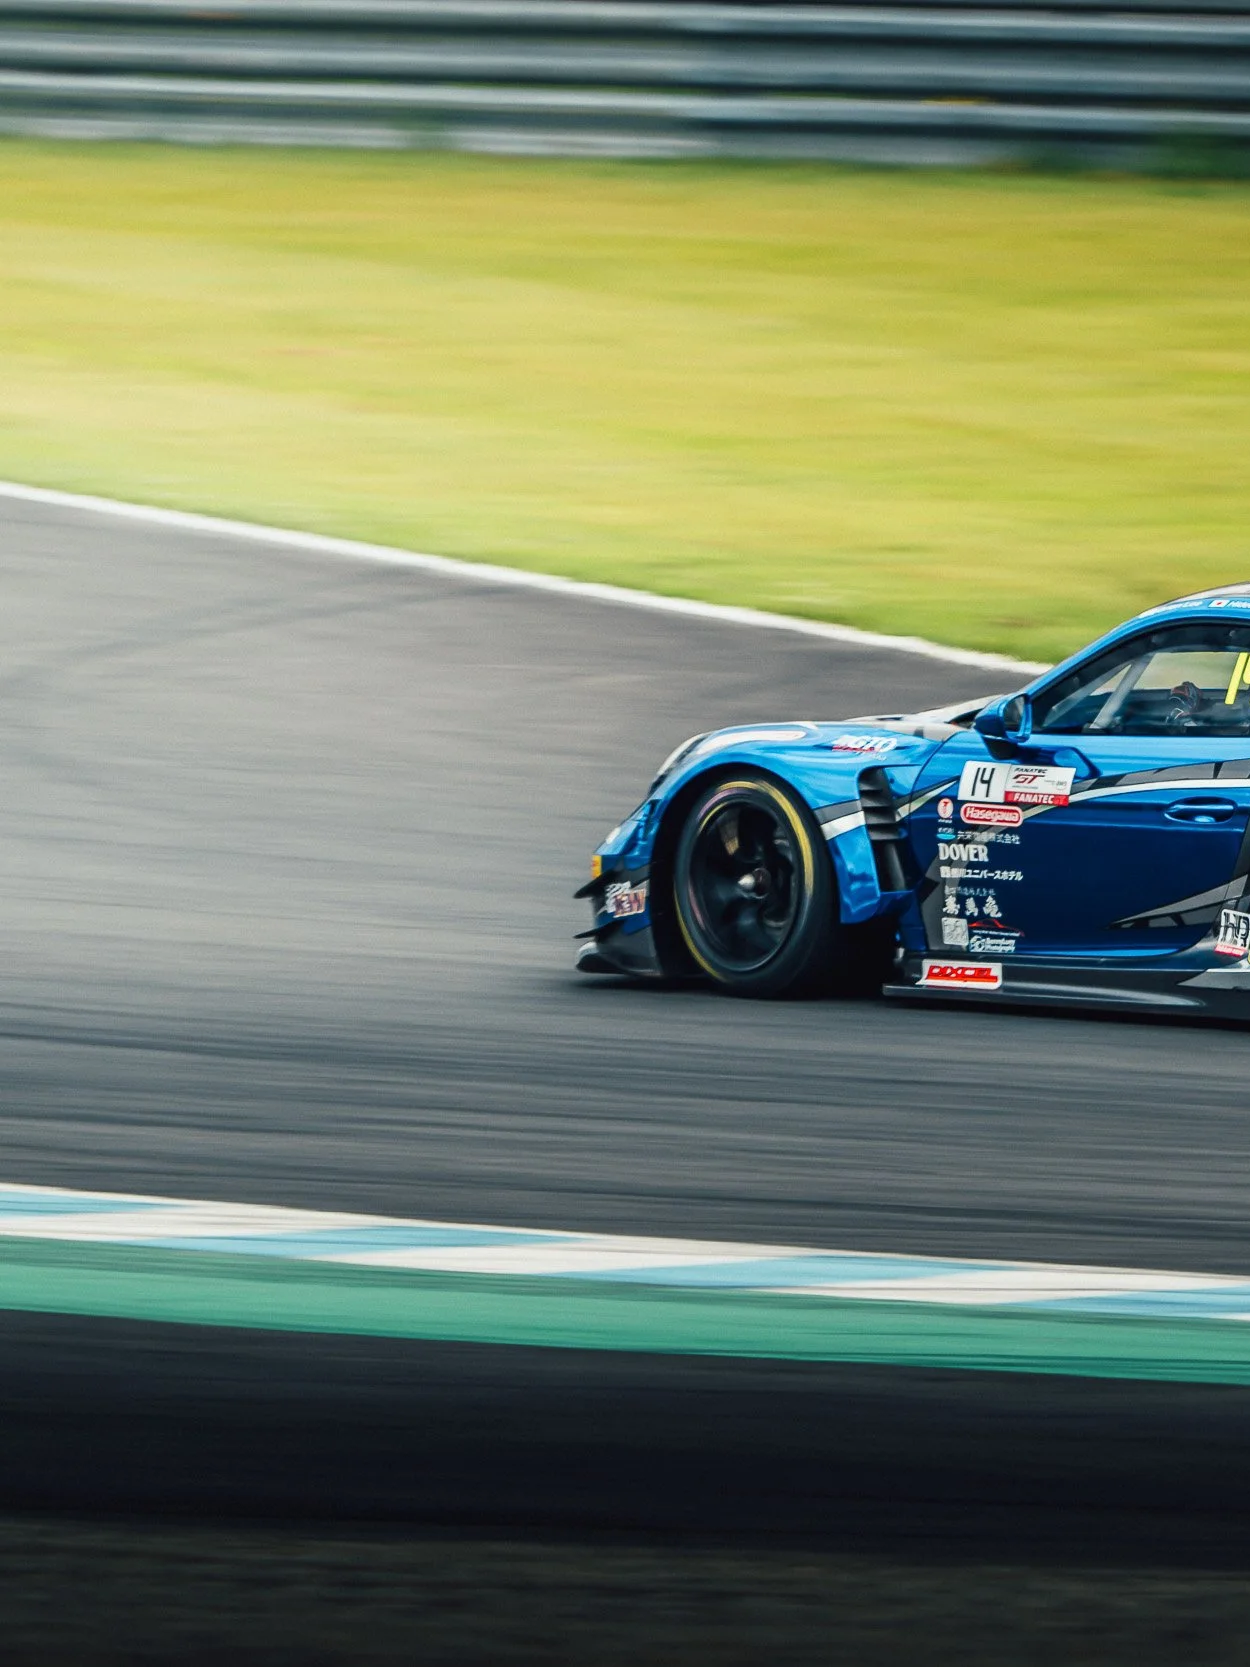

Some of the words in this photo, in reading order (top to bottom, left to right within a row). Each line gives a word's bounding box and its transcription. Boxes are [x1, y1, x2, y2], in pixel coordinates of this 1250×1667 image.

[970, 766, 996, 798] 14
[1012, 793, 1054, 805] FANATEC
[966, 806, 1020, 823] Hasegawa
[937, 843, 989, 863] DOVER
